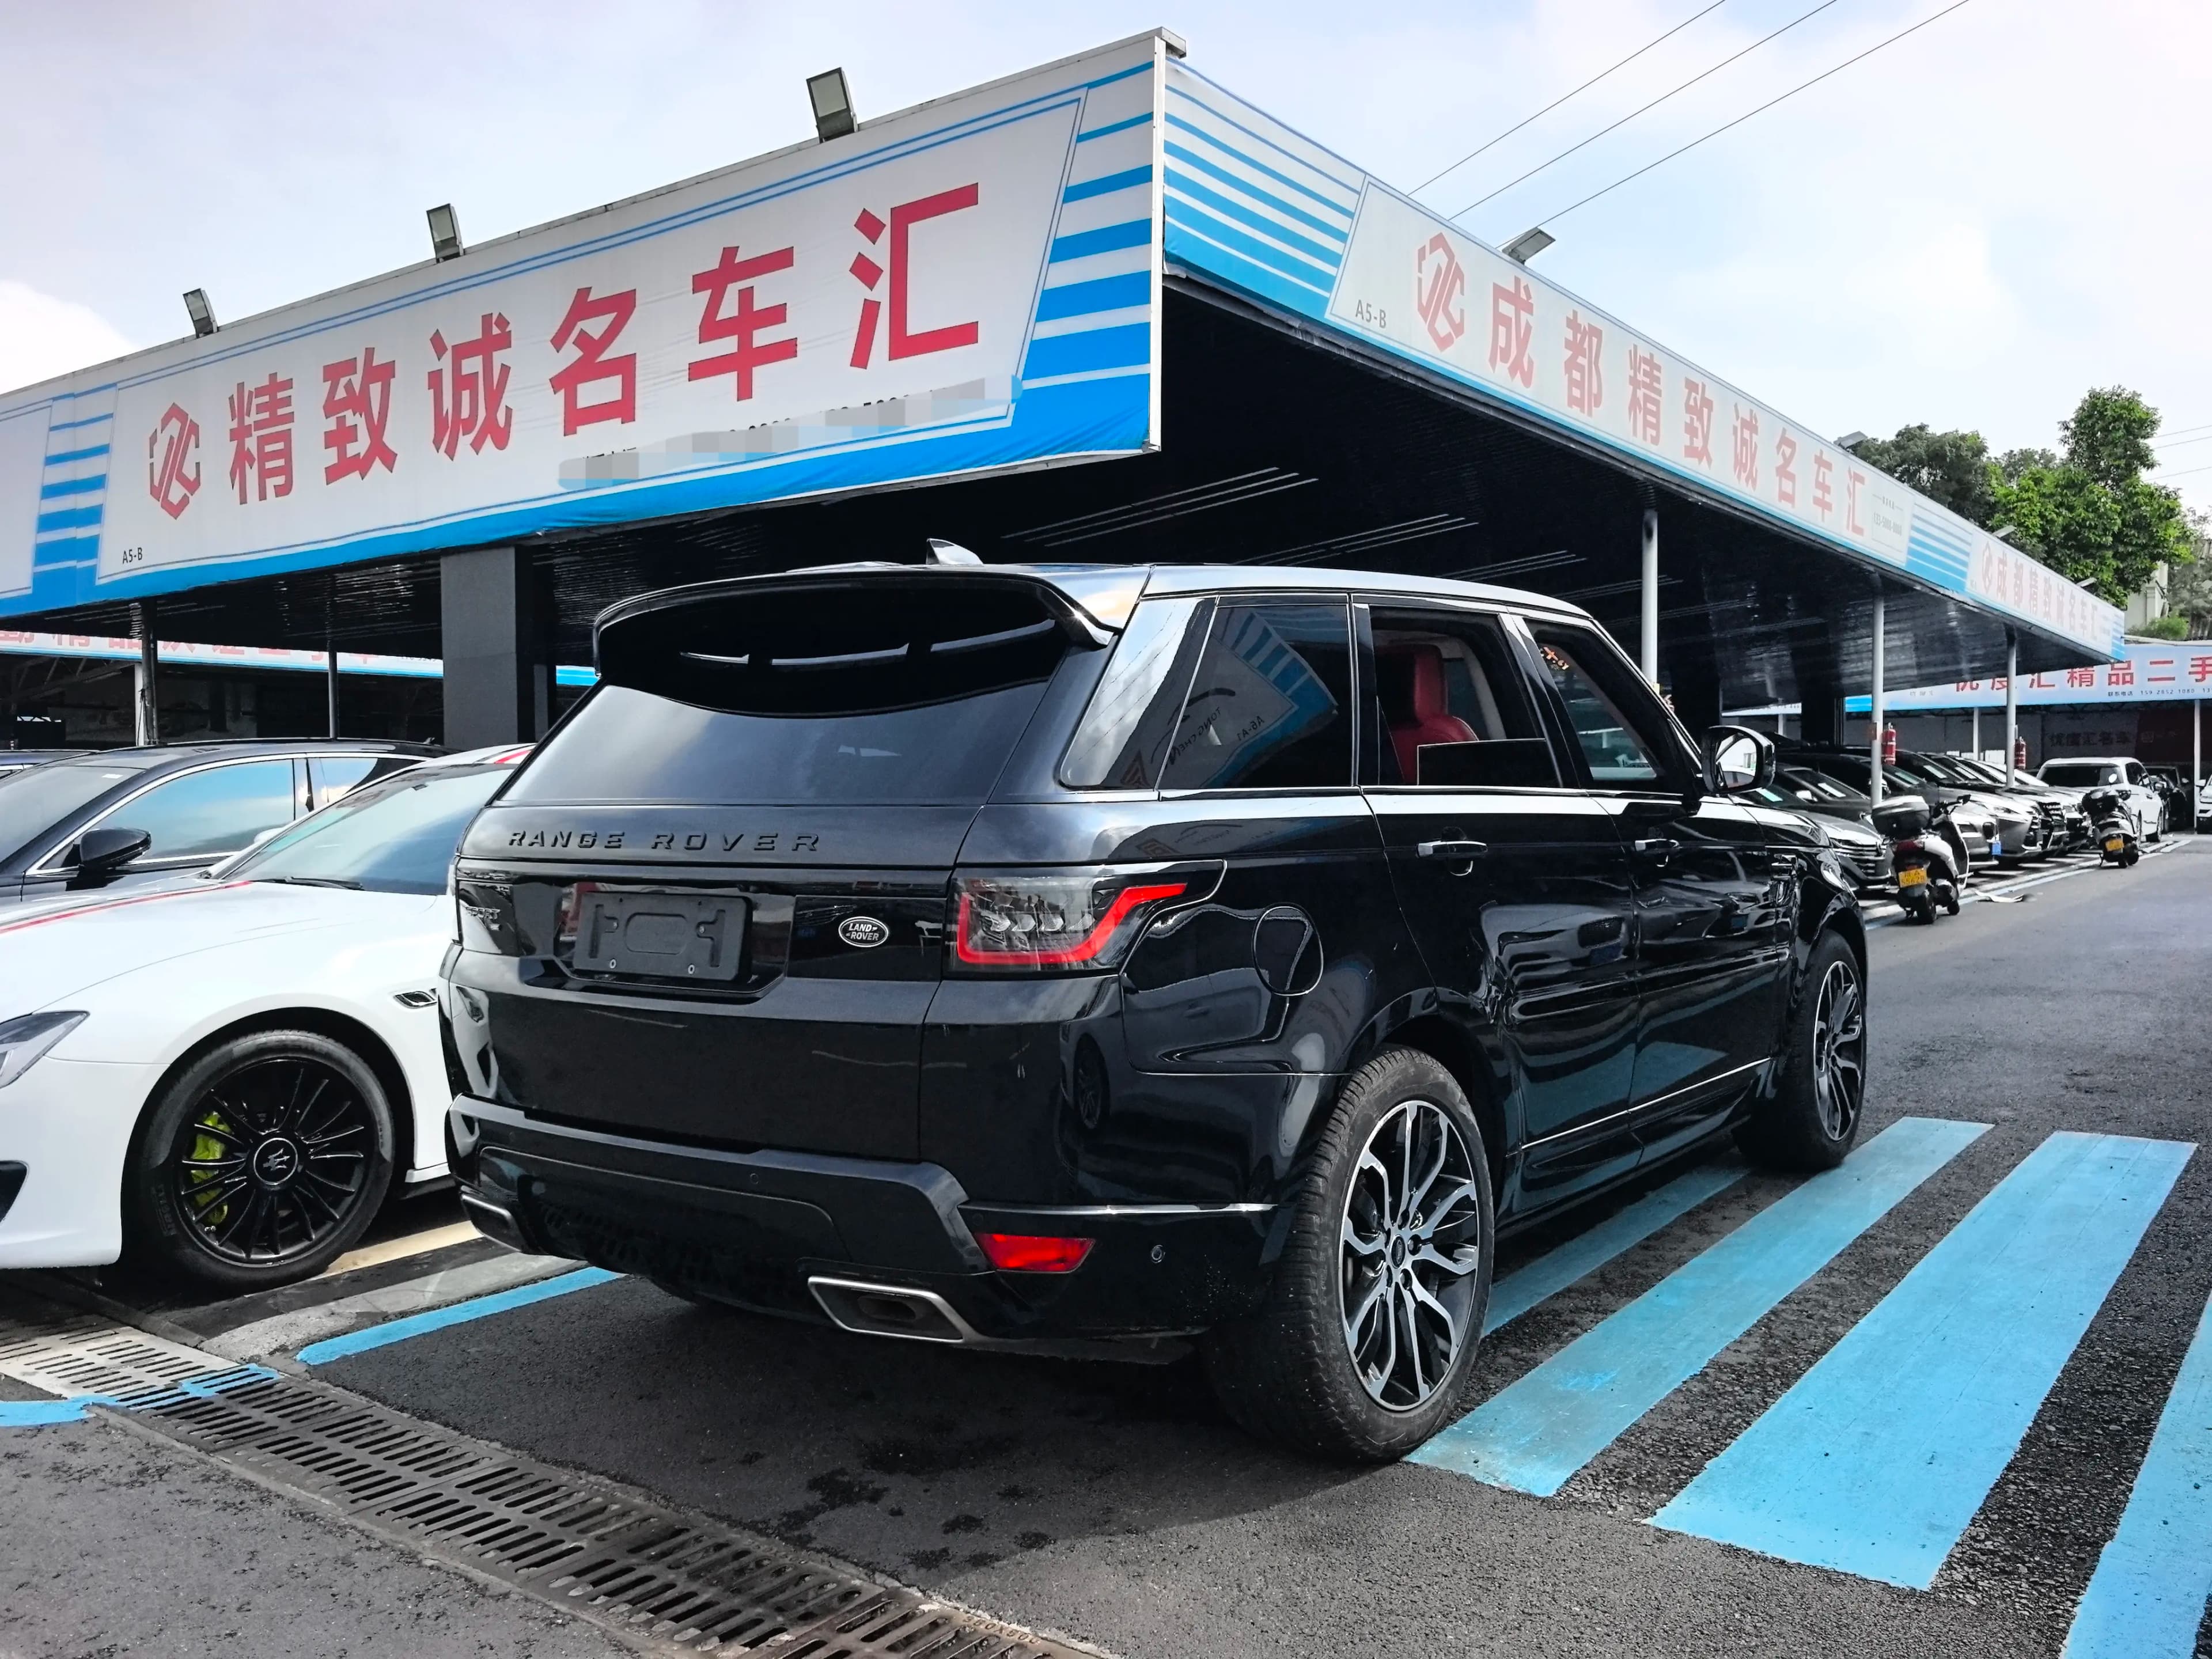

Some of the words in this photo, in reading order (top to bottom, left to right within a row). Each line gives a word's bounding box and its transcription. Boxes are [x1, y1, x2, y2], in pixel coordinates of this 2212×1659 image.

[1355, 299, 1387, 329] A5-B
[228, 183, 979, 505] 精致诚名车汇
[1488, 275, 1865, 537] 成都精致诚名车汇
[122, 547, 143, 565] A5-B
[509, 830, 626, 849] RANGE
[651, 831, 820, 852] ROVER
[849, 923, 872, 932] LAND
[850, 931, 880, 941] ROVER
